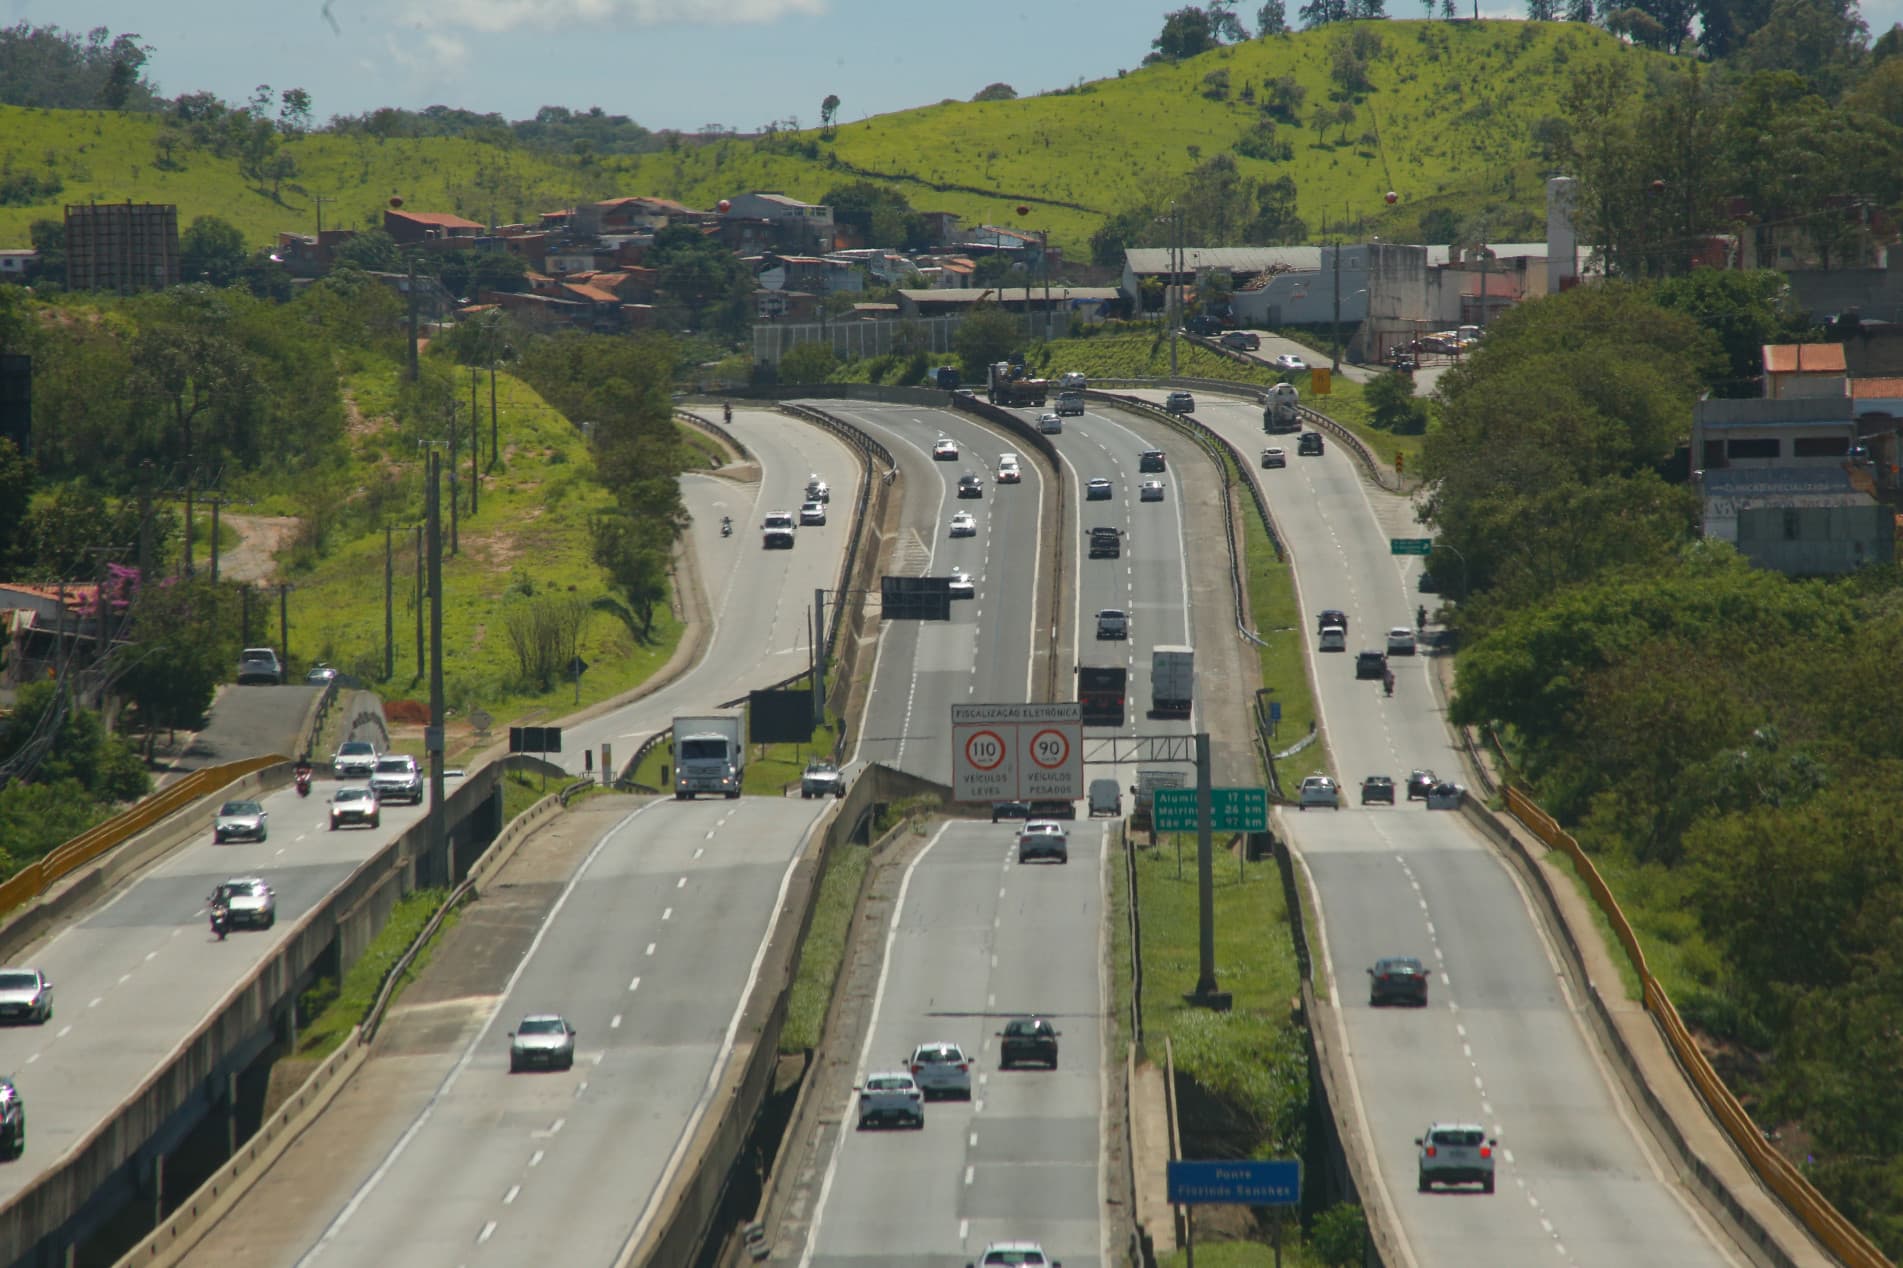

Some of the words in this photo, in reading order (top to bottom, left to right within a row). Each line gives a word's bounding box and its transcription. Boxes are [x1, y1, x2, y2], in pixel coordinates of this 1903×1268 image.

[1023, 706, 1078, 717] ELETRÔNICA
[973, 741, 996, 757] 110
[1039, 741, 1060, 756] 90
[971, 786, 1001, 796] LEVES
[1029, 785, 1072, 794] PESADOS
[1227, 791, 1239, 803] 17
[1244, 792, 1262, 803] km
[1244, 804, 1262, 815] km
[1184, 818, 1217, 828] Pao
[1244, 816, 1262, 828] km
